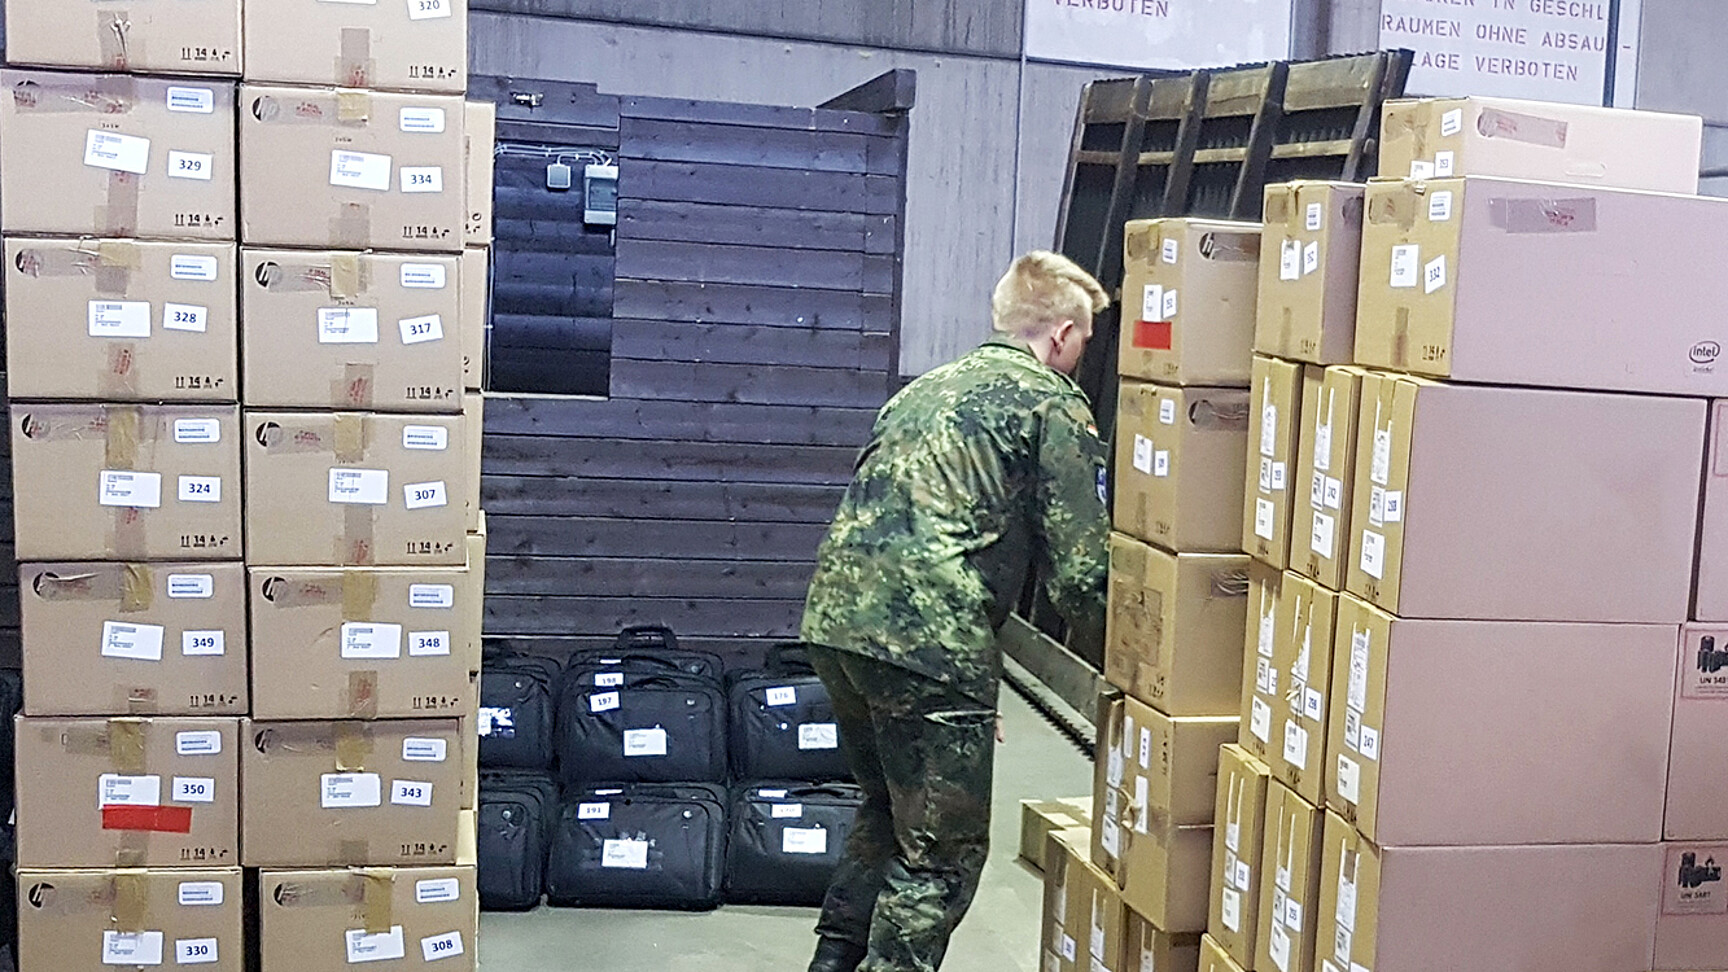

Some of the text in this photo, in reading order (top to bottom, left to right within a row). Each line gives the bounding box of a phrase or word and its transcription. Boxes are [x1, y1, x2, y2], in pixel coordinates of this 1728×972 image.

[419, 0, 440, 11] 320
[1381, 14, 1460, 38] RAUMEN
[1475, 24, 1527, 45] OHNE
[1474, 56, 1578, 81] VERBOTEN
[179, 159, 202, 171] 329
[410, 174, 433, 185] 334
[173, 311, 197, 324] 328
[410, 323, 432, 335] 317
[188, 483, 211, 494] 324
[414, 489, 436, 501] 307
[192, 637, 215, 649] 349
[418, 637, 440, 649] 348
[182, 783, 205, 795] 350
[400, 787, 422, 798] 343
[185, 945, 209, 956] 330
[431, 939, 454, 952] 308
